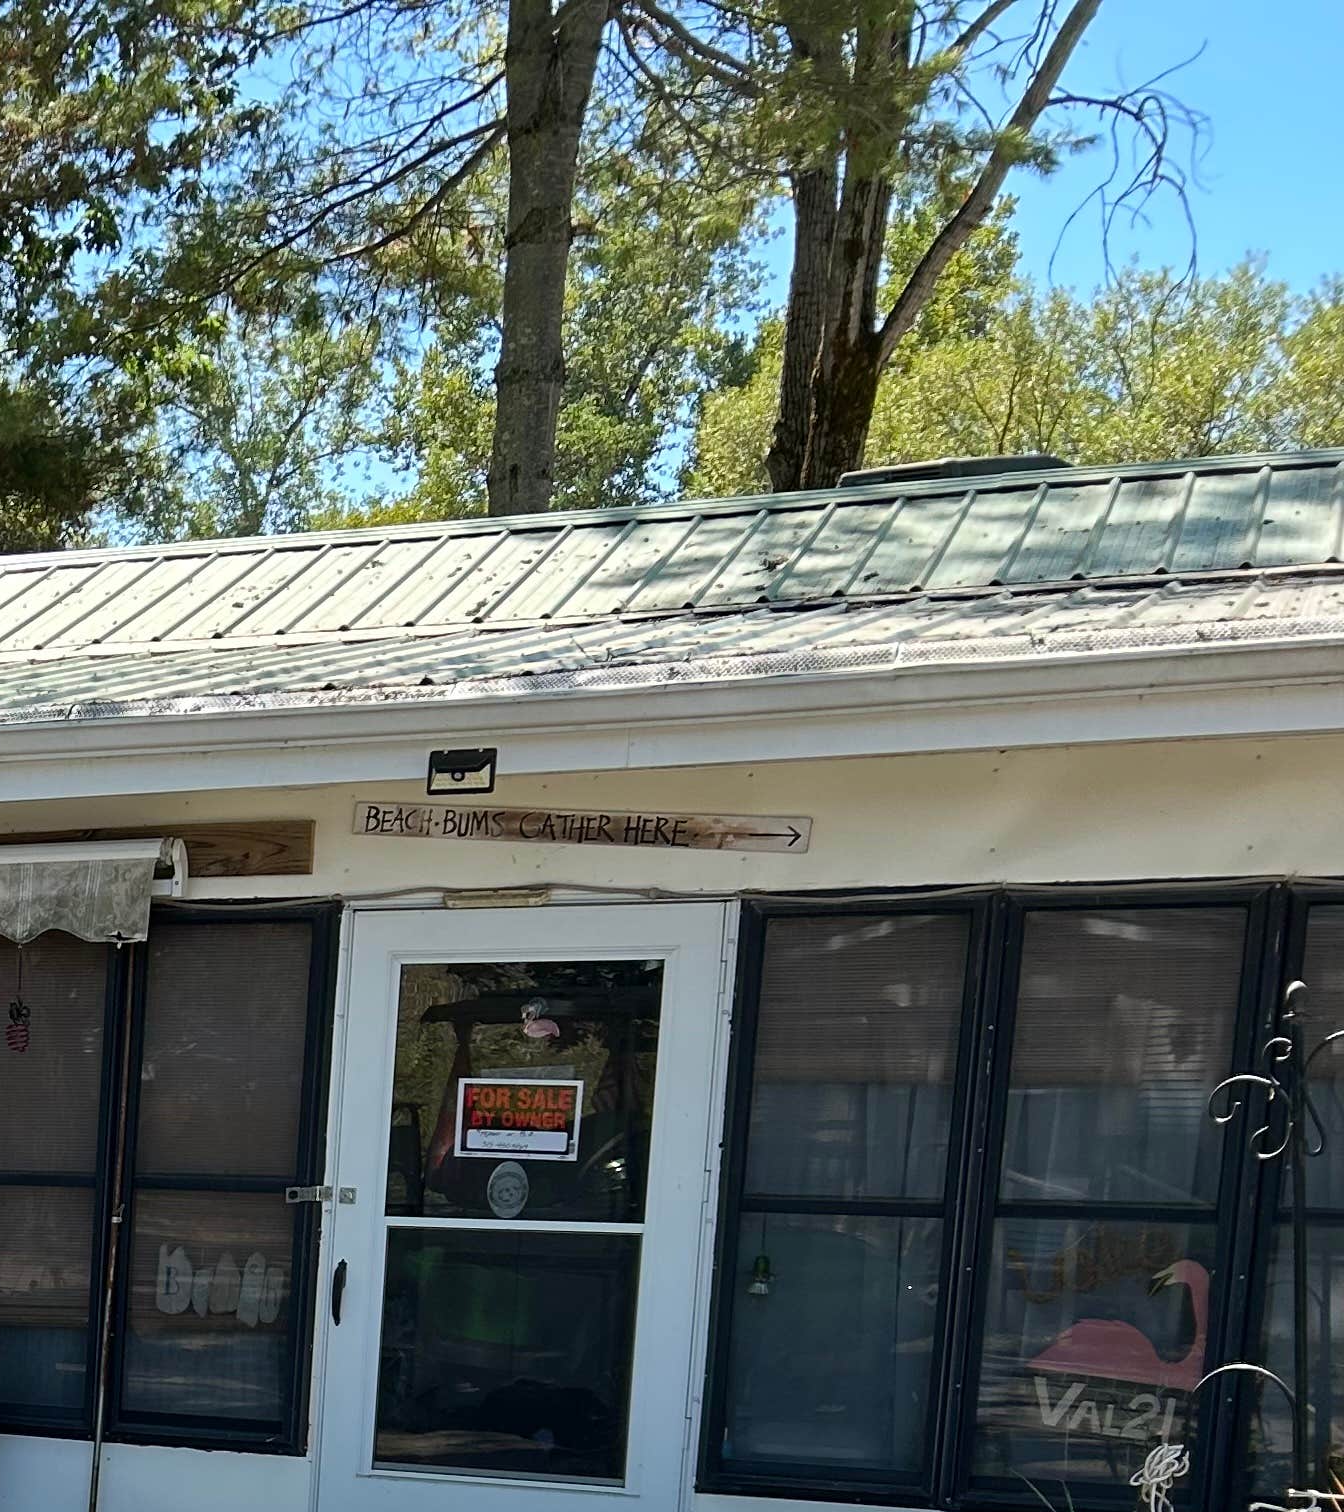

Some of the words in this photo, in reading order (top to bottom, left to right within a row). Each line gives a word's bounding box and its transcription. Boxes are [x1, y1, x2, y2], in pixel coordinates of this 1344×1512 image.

[442, 809, 506, 837] BUMS
[623, 815, 690, 847] HERE
[465, 1086, 511, 1109] FOR
[517, 1087, 575, 1111] SALE
[470, 1109, 497, 1127] BY
[501, 1110, 567, 1129] OWNER
